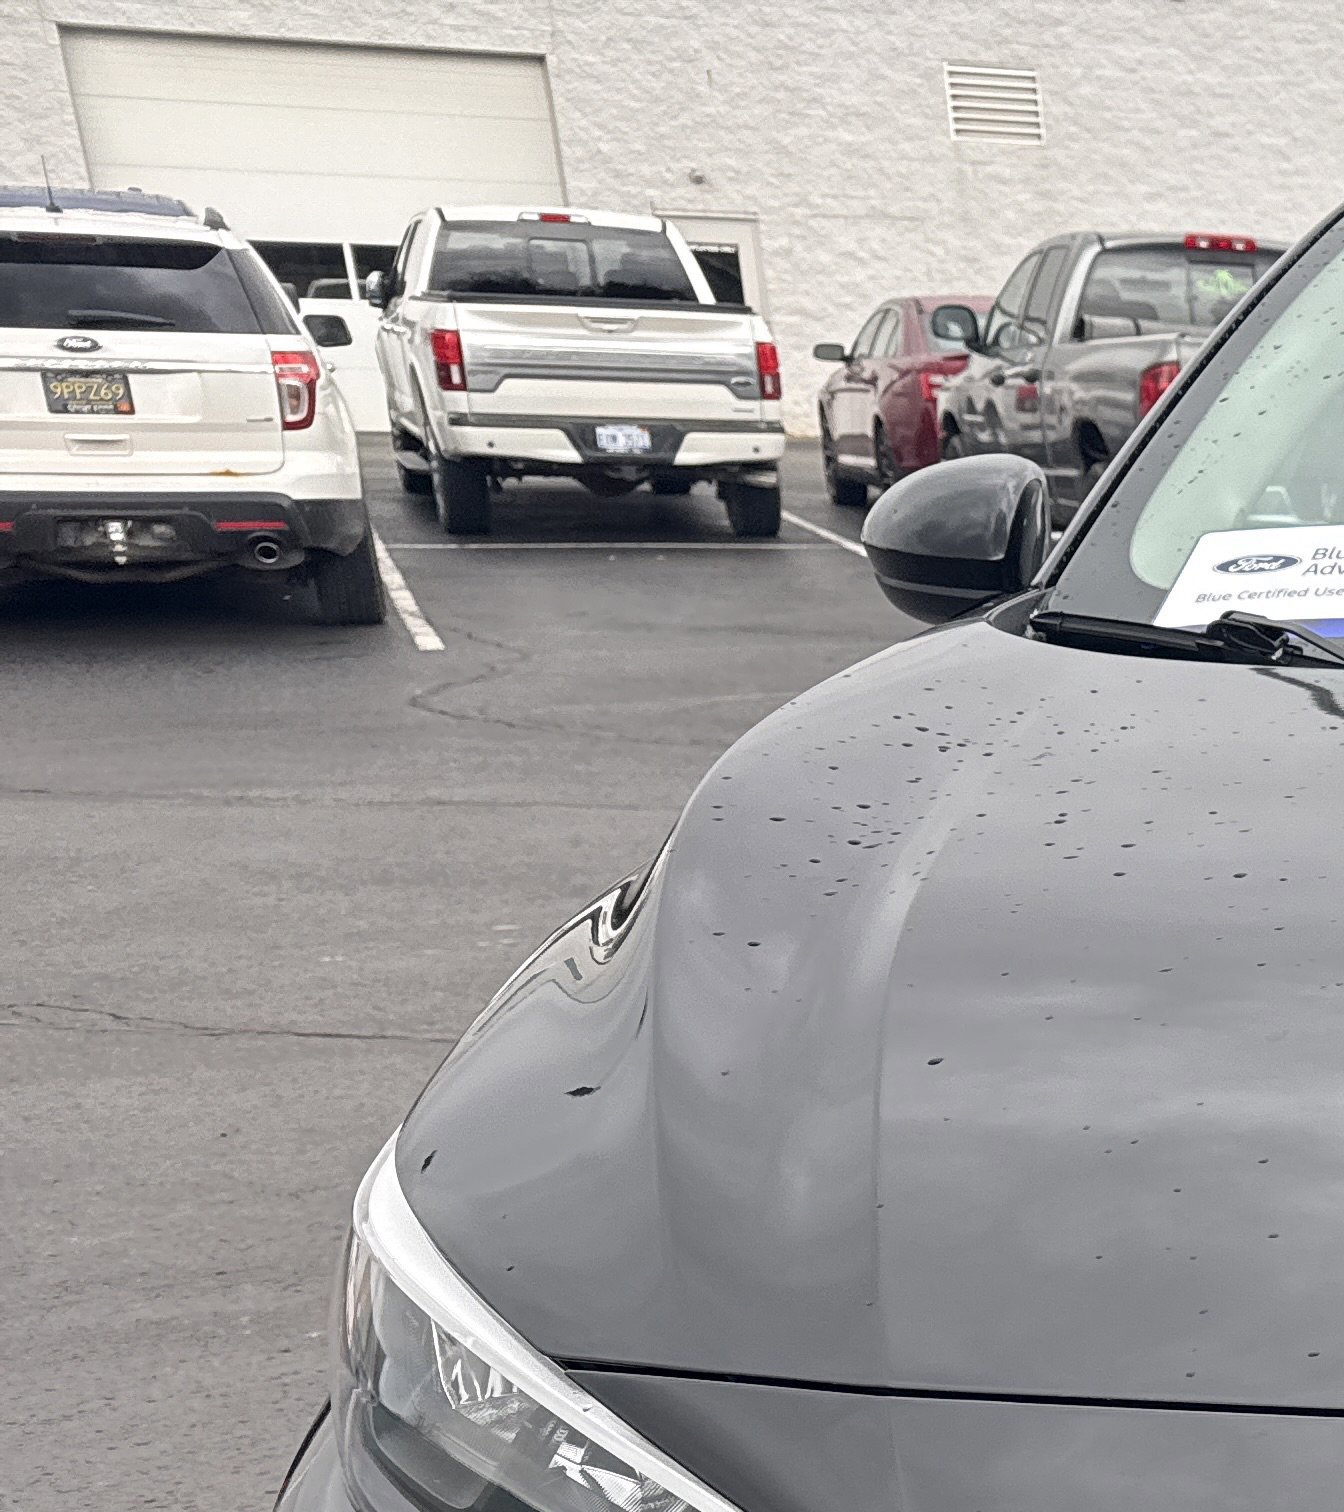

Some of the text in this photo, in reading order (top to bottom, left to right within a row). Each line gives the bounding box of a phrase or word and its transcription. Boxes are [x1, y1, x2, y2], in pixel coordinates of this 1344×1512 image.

[49, 381, 125, 401] 9PPZ69
[1226, 555, 1288, 573] Ford
[1195, 592, 1233, 603] Blue
[1237, 587, 1310, 600] Certified
